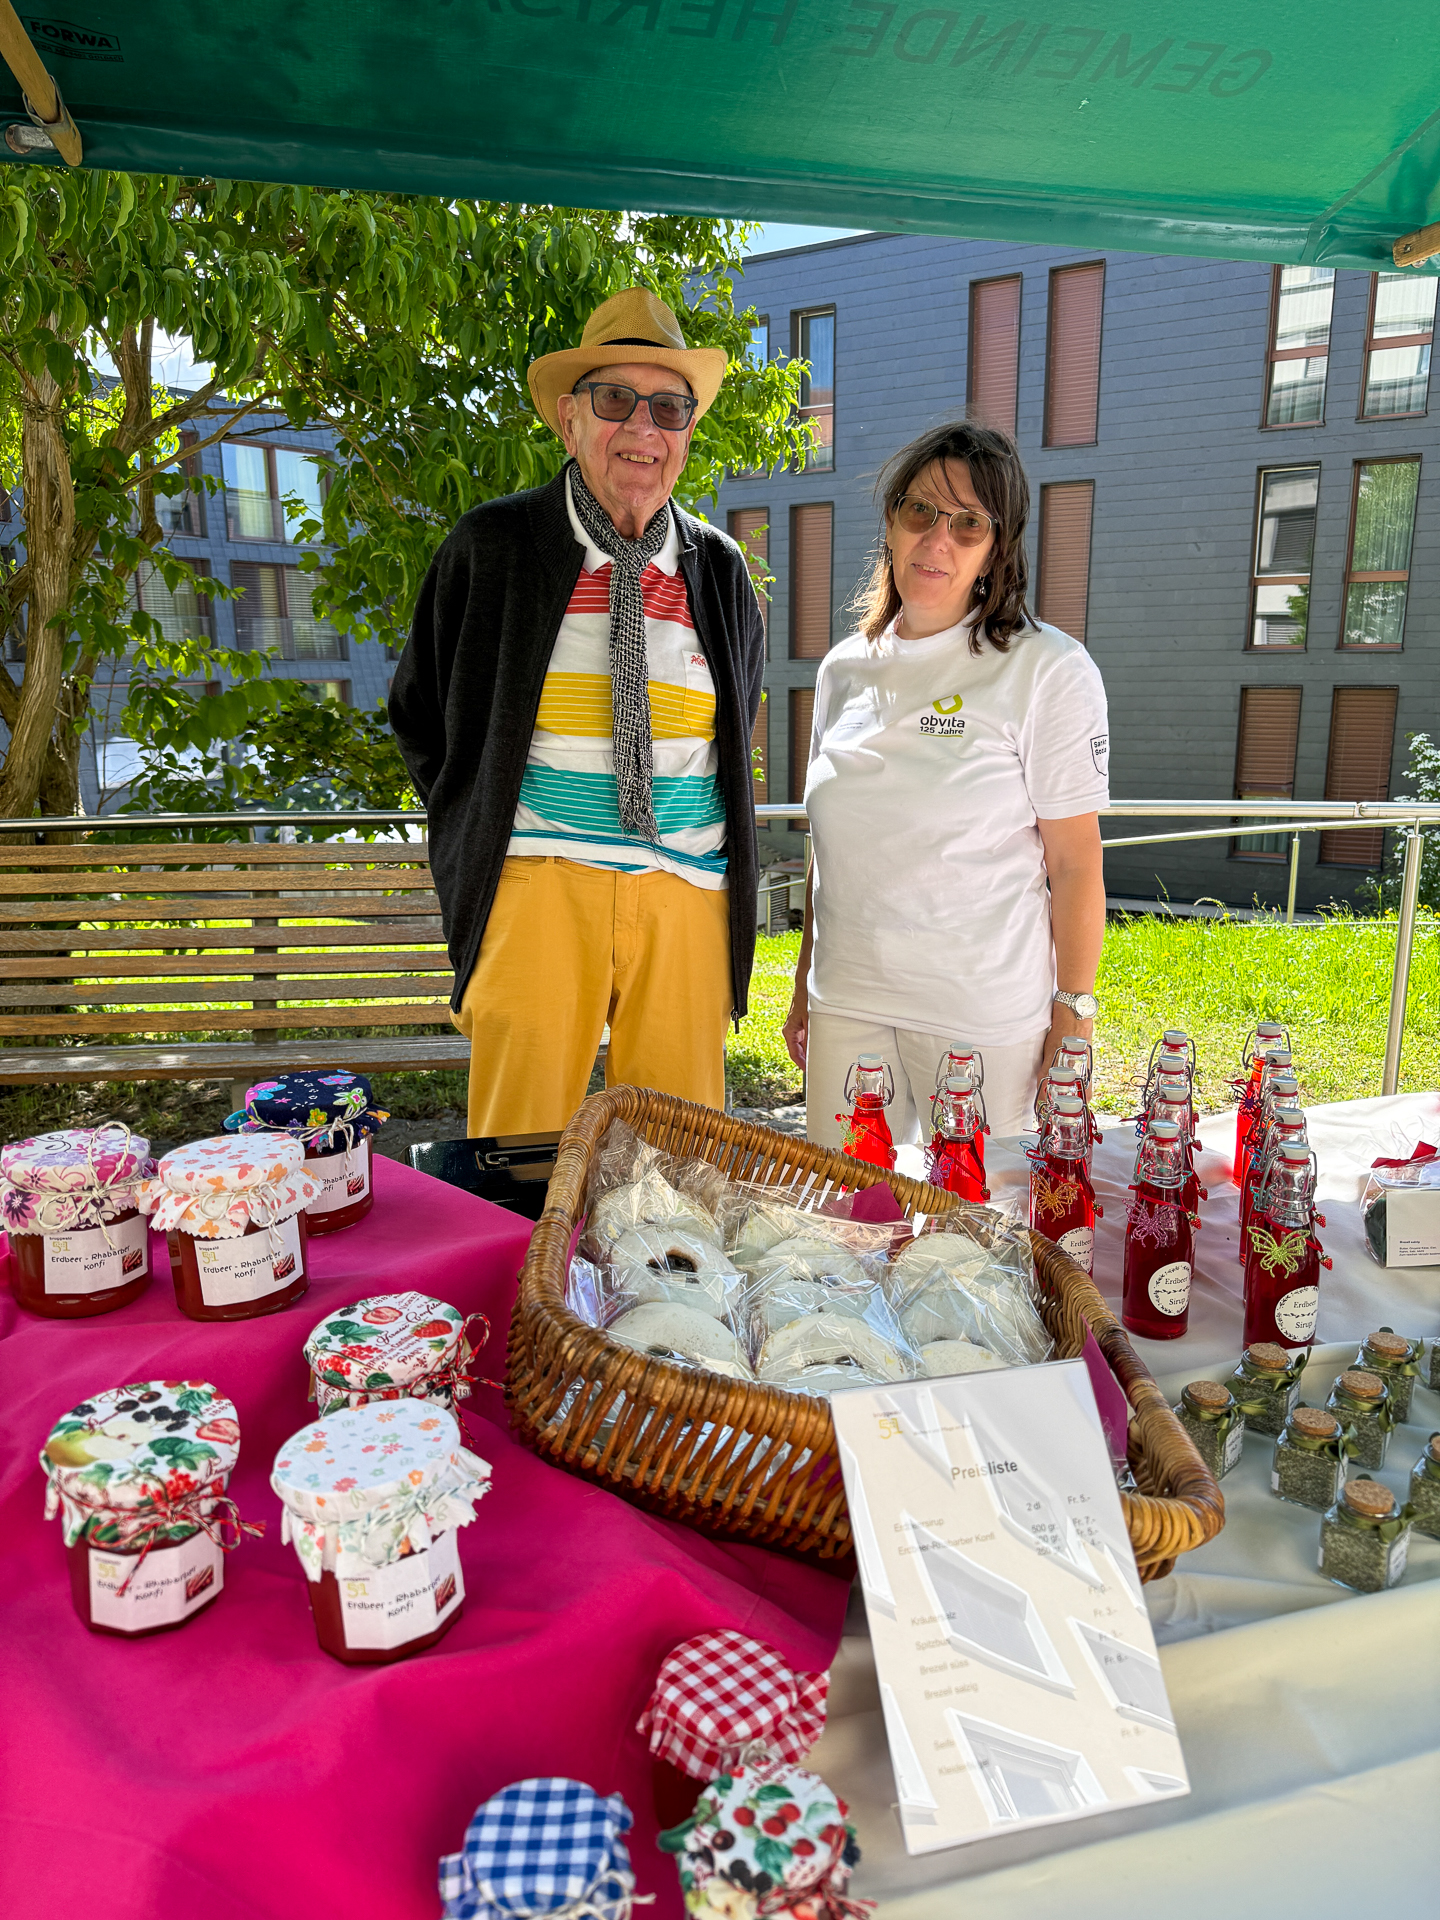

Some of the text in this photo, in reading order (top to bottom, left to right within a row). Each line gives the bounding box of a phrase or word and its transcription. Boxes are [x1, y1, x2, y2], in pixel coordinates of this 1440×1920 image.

[30, 21, 113, 48] FORWA
[920, 715, 966, 728] obvita
[919, 726, 964, 735] 125 Jahre
[1070, 1238, 1092, 1248] Erdbeer
[91, 1245, 131, 1261] Rhabarber
[83, 1260, 106, 1271] Konfi
[203, 1264, 232, 1274] Erdbeer
[234, 1267, 256, 1279] Konfi
[1164, 1276, 1189, 1285] Erdbeer
[1169, 1297, 1186, 1306] Sirup
[1293, 1299, 1318, 1309] Erdbeer
[1295, 1320, 1313, 1330] Sirup
[951, 1459, 1018, 1480] Preisliste
[1067, 1496, 1079, 1505] Fr.
[1032, 1523, 1046, 1533] 500
[1072, 1517, 1084, 1526] Fr.
[974, 1532, 996, 1542] Konfi
[347, 1601, 385, 1610] Erdbeer
[388, 1600, 414, 1618] Konfi
[1104, 1654, 1116, 1665] Fr.
